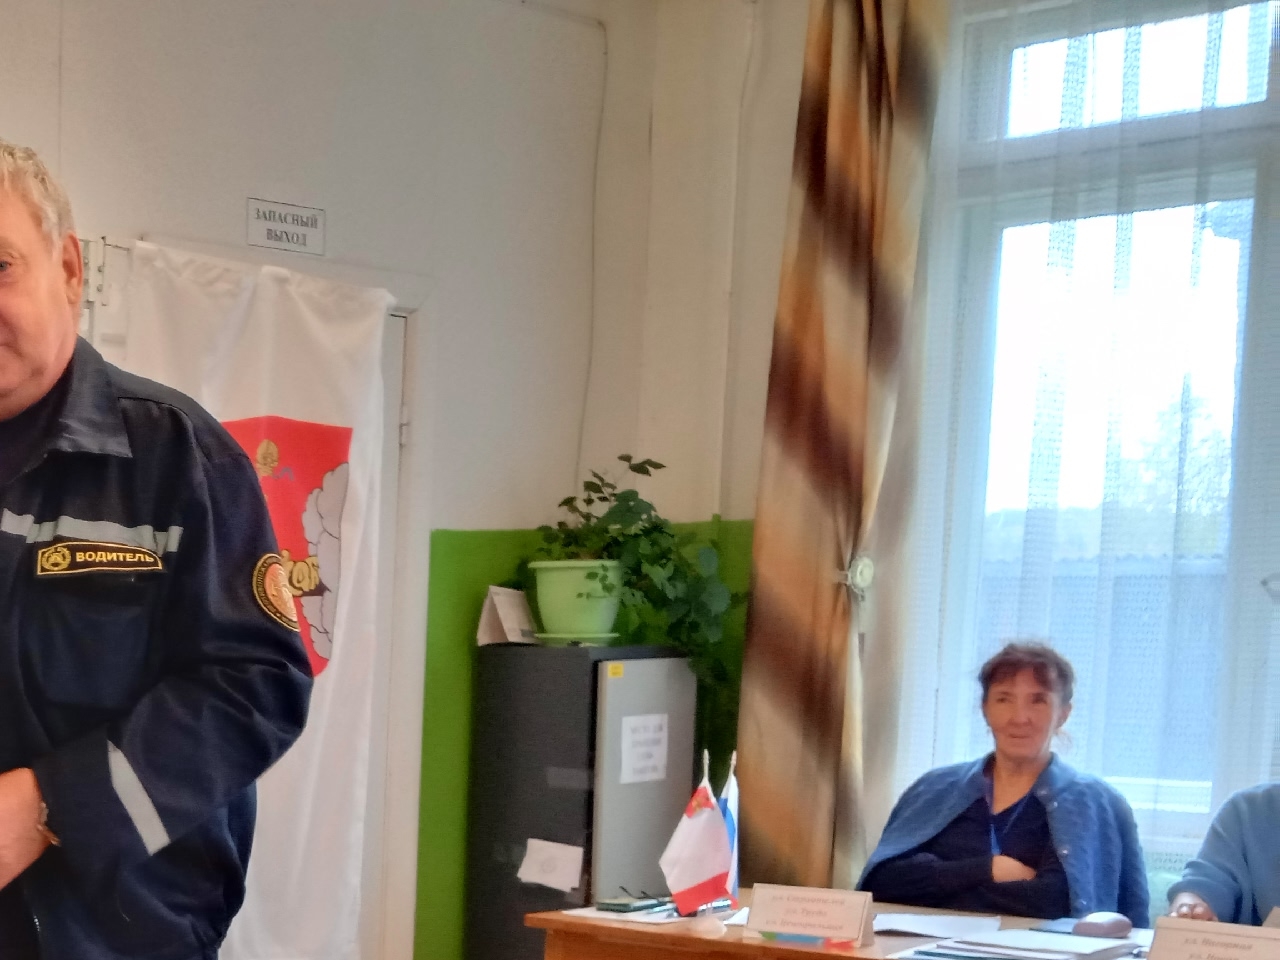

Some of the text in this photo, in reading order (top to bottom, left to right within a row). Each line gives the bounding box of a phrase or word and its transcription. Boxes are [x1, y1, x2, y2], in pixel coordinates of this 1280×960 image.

[255, 208, 318, 229] ЗАПАСНЫЙ
[266, 228, 307, 246] ВЫХОД
[76, 551, 155, 563] ВОДИТЕЛЬ
